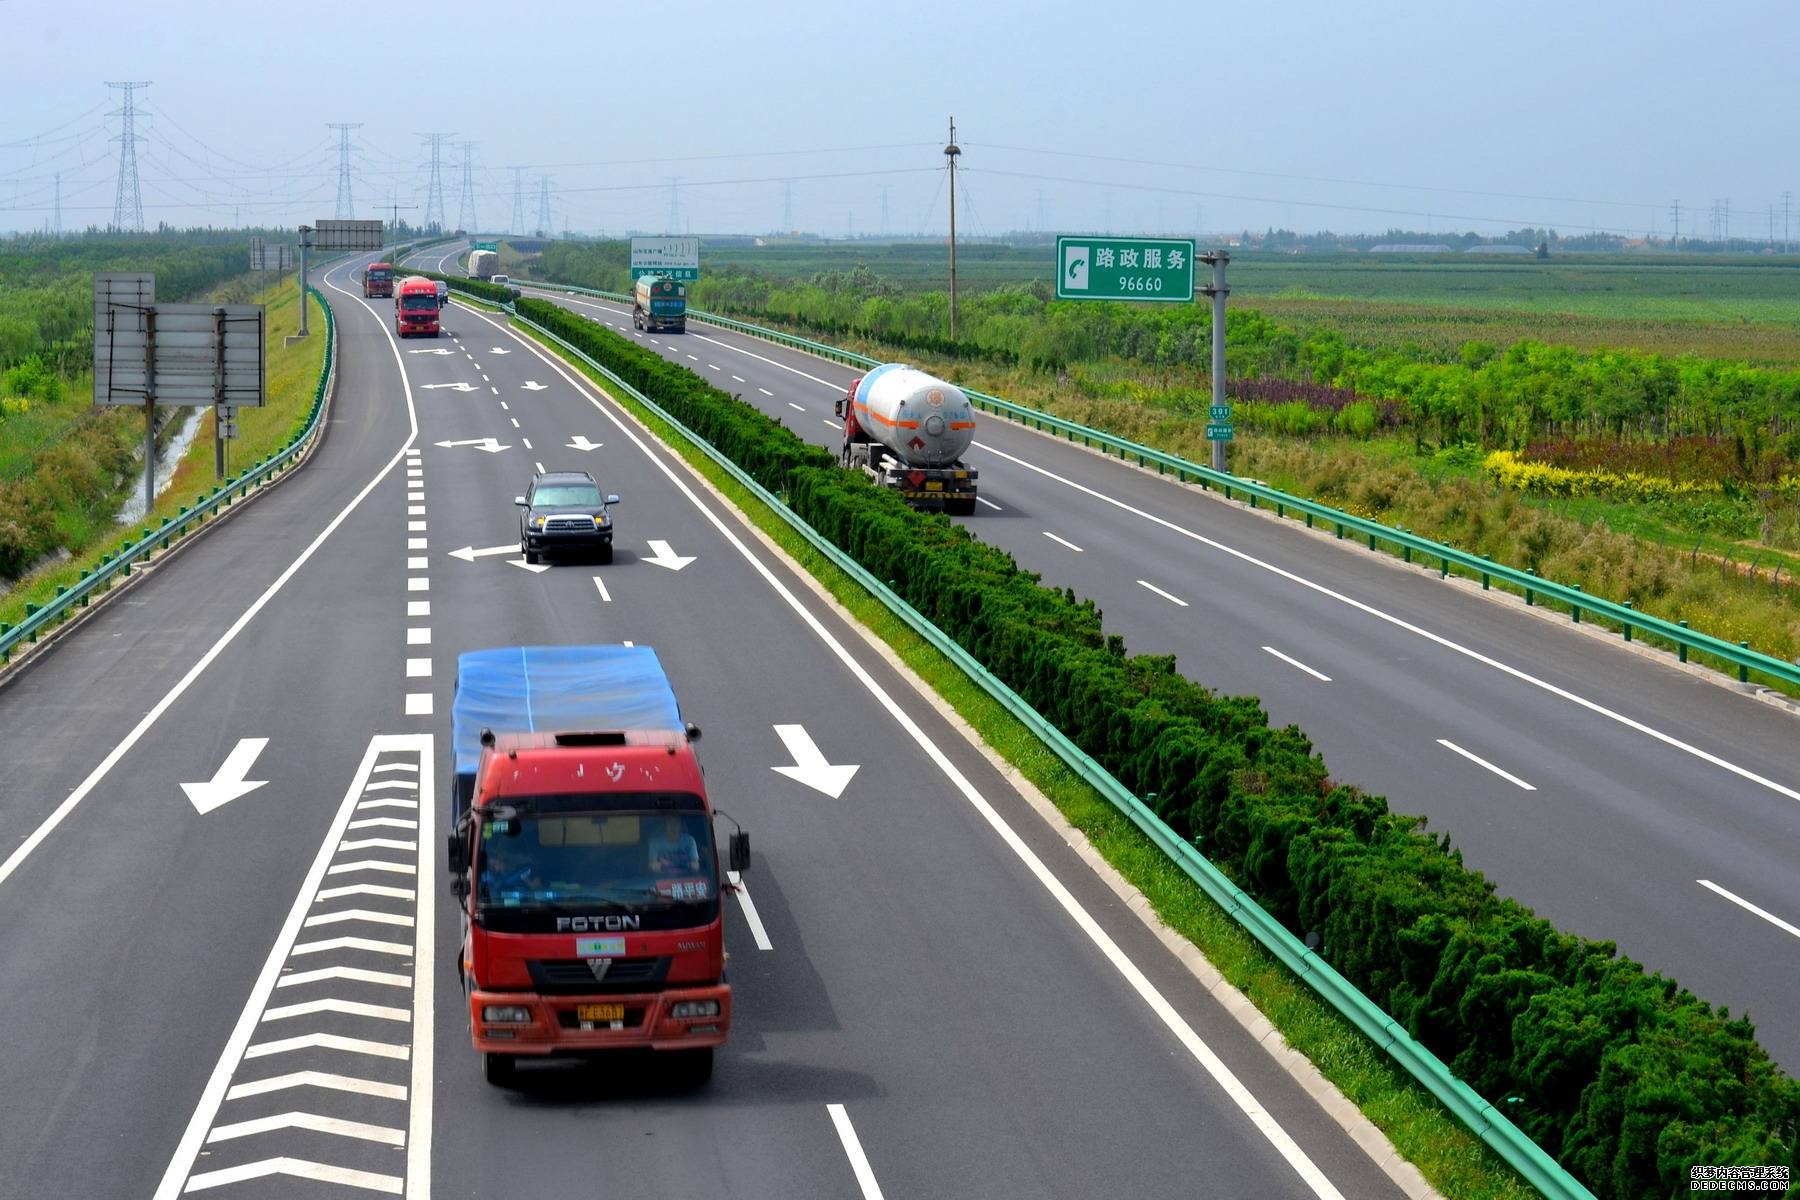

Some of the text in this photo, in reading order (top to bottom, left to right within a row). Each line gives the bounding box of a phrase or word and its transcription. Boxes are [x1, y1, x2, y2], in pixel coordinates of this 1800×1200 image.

[1095, 248, 1186, 269] 路政服务
[1119, 276, 1162, 292] 96660
[1212, 407, 1229, 416] 391
[556, 914, 640, 932] FOTON
